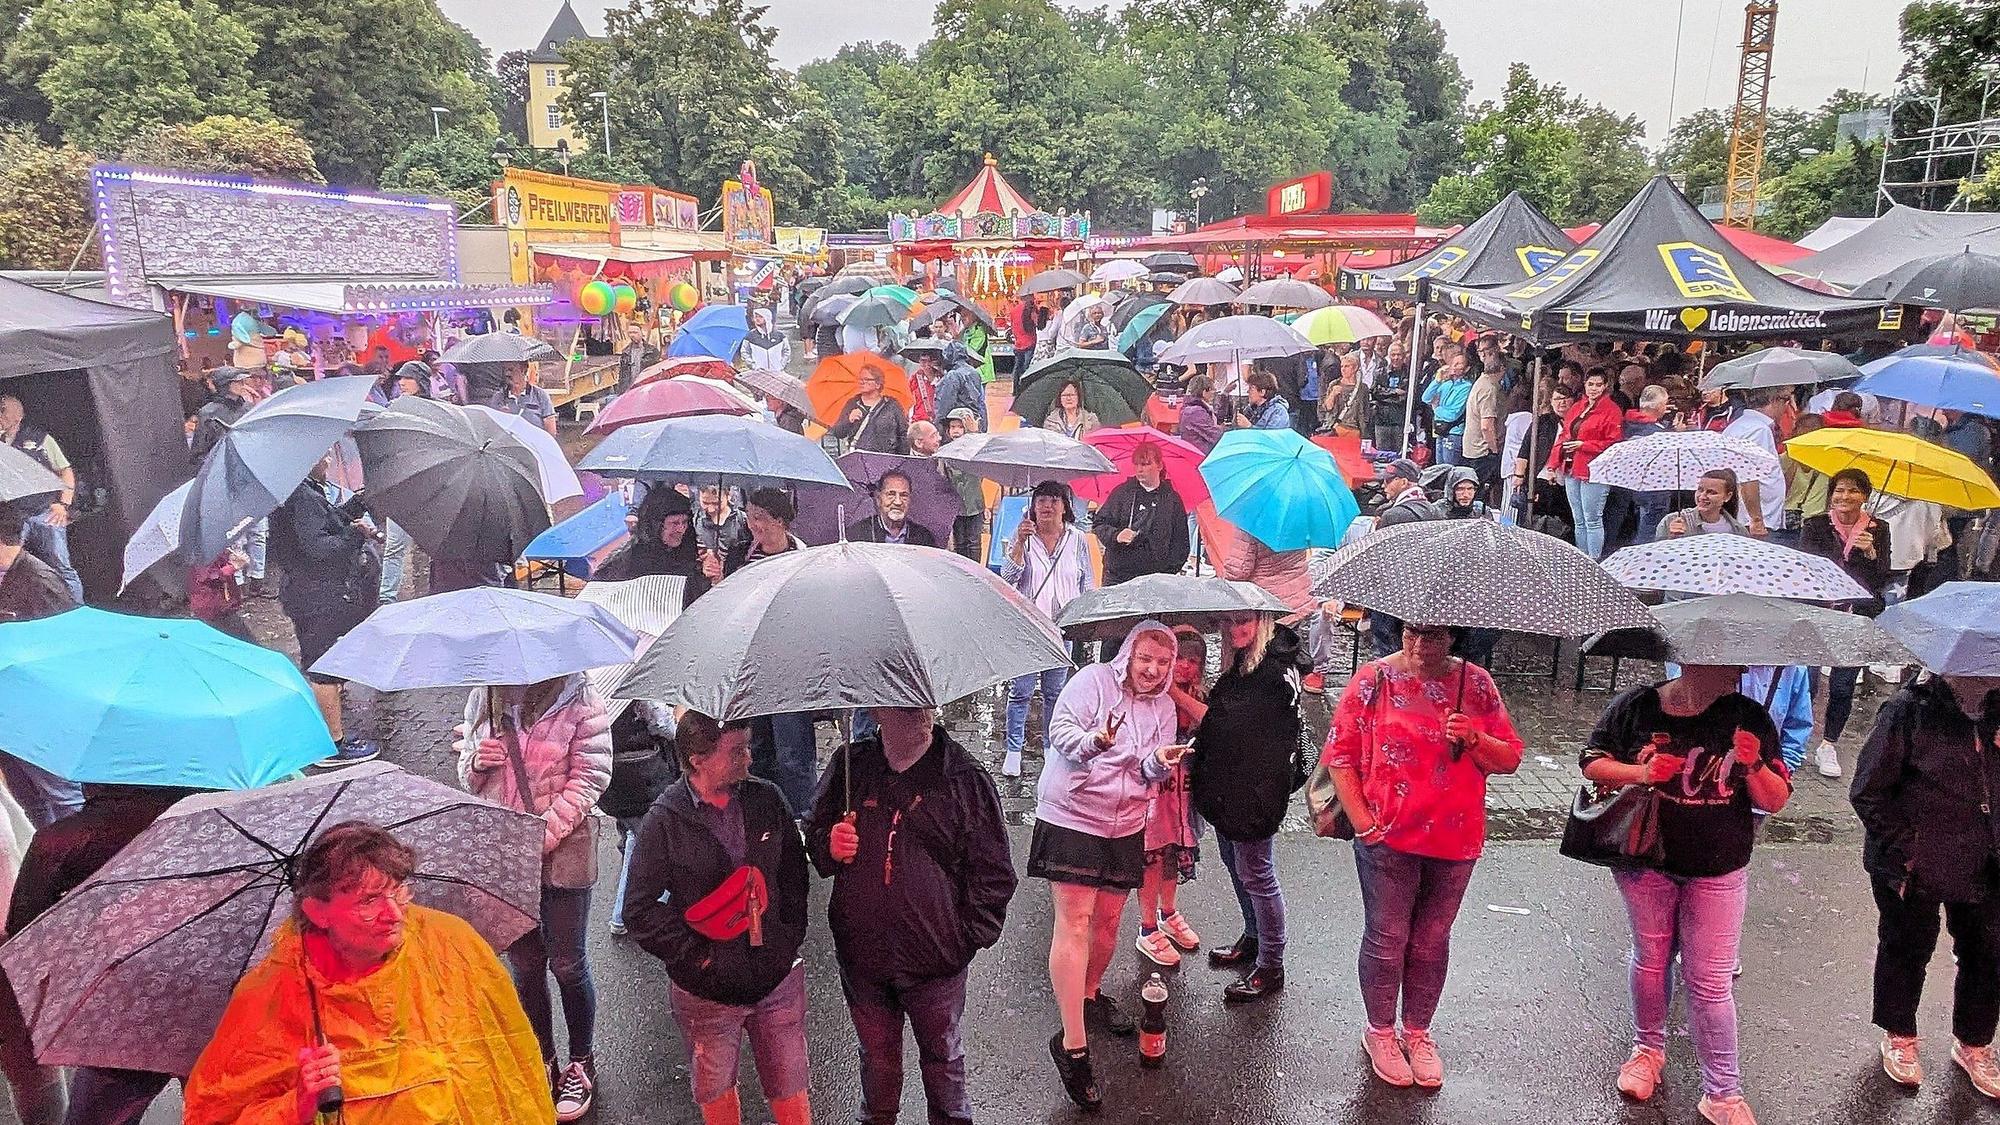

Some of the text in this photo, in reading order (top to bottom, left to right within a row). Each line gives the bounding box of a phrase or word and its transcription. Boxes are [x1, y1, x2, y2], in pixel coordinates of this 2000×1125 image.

[528, 193, 608, 224] PFEILWERFEN
[1688, 284, 1747, 297] EDEKA
[1645, 309, 1827, 332] Wir Lebensmittel.
